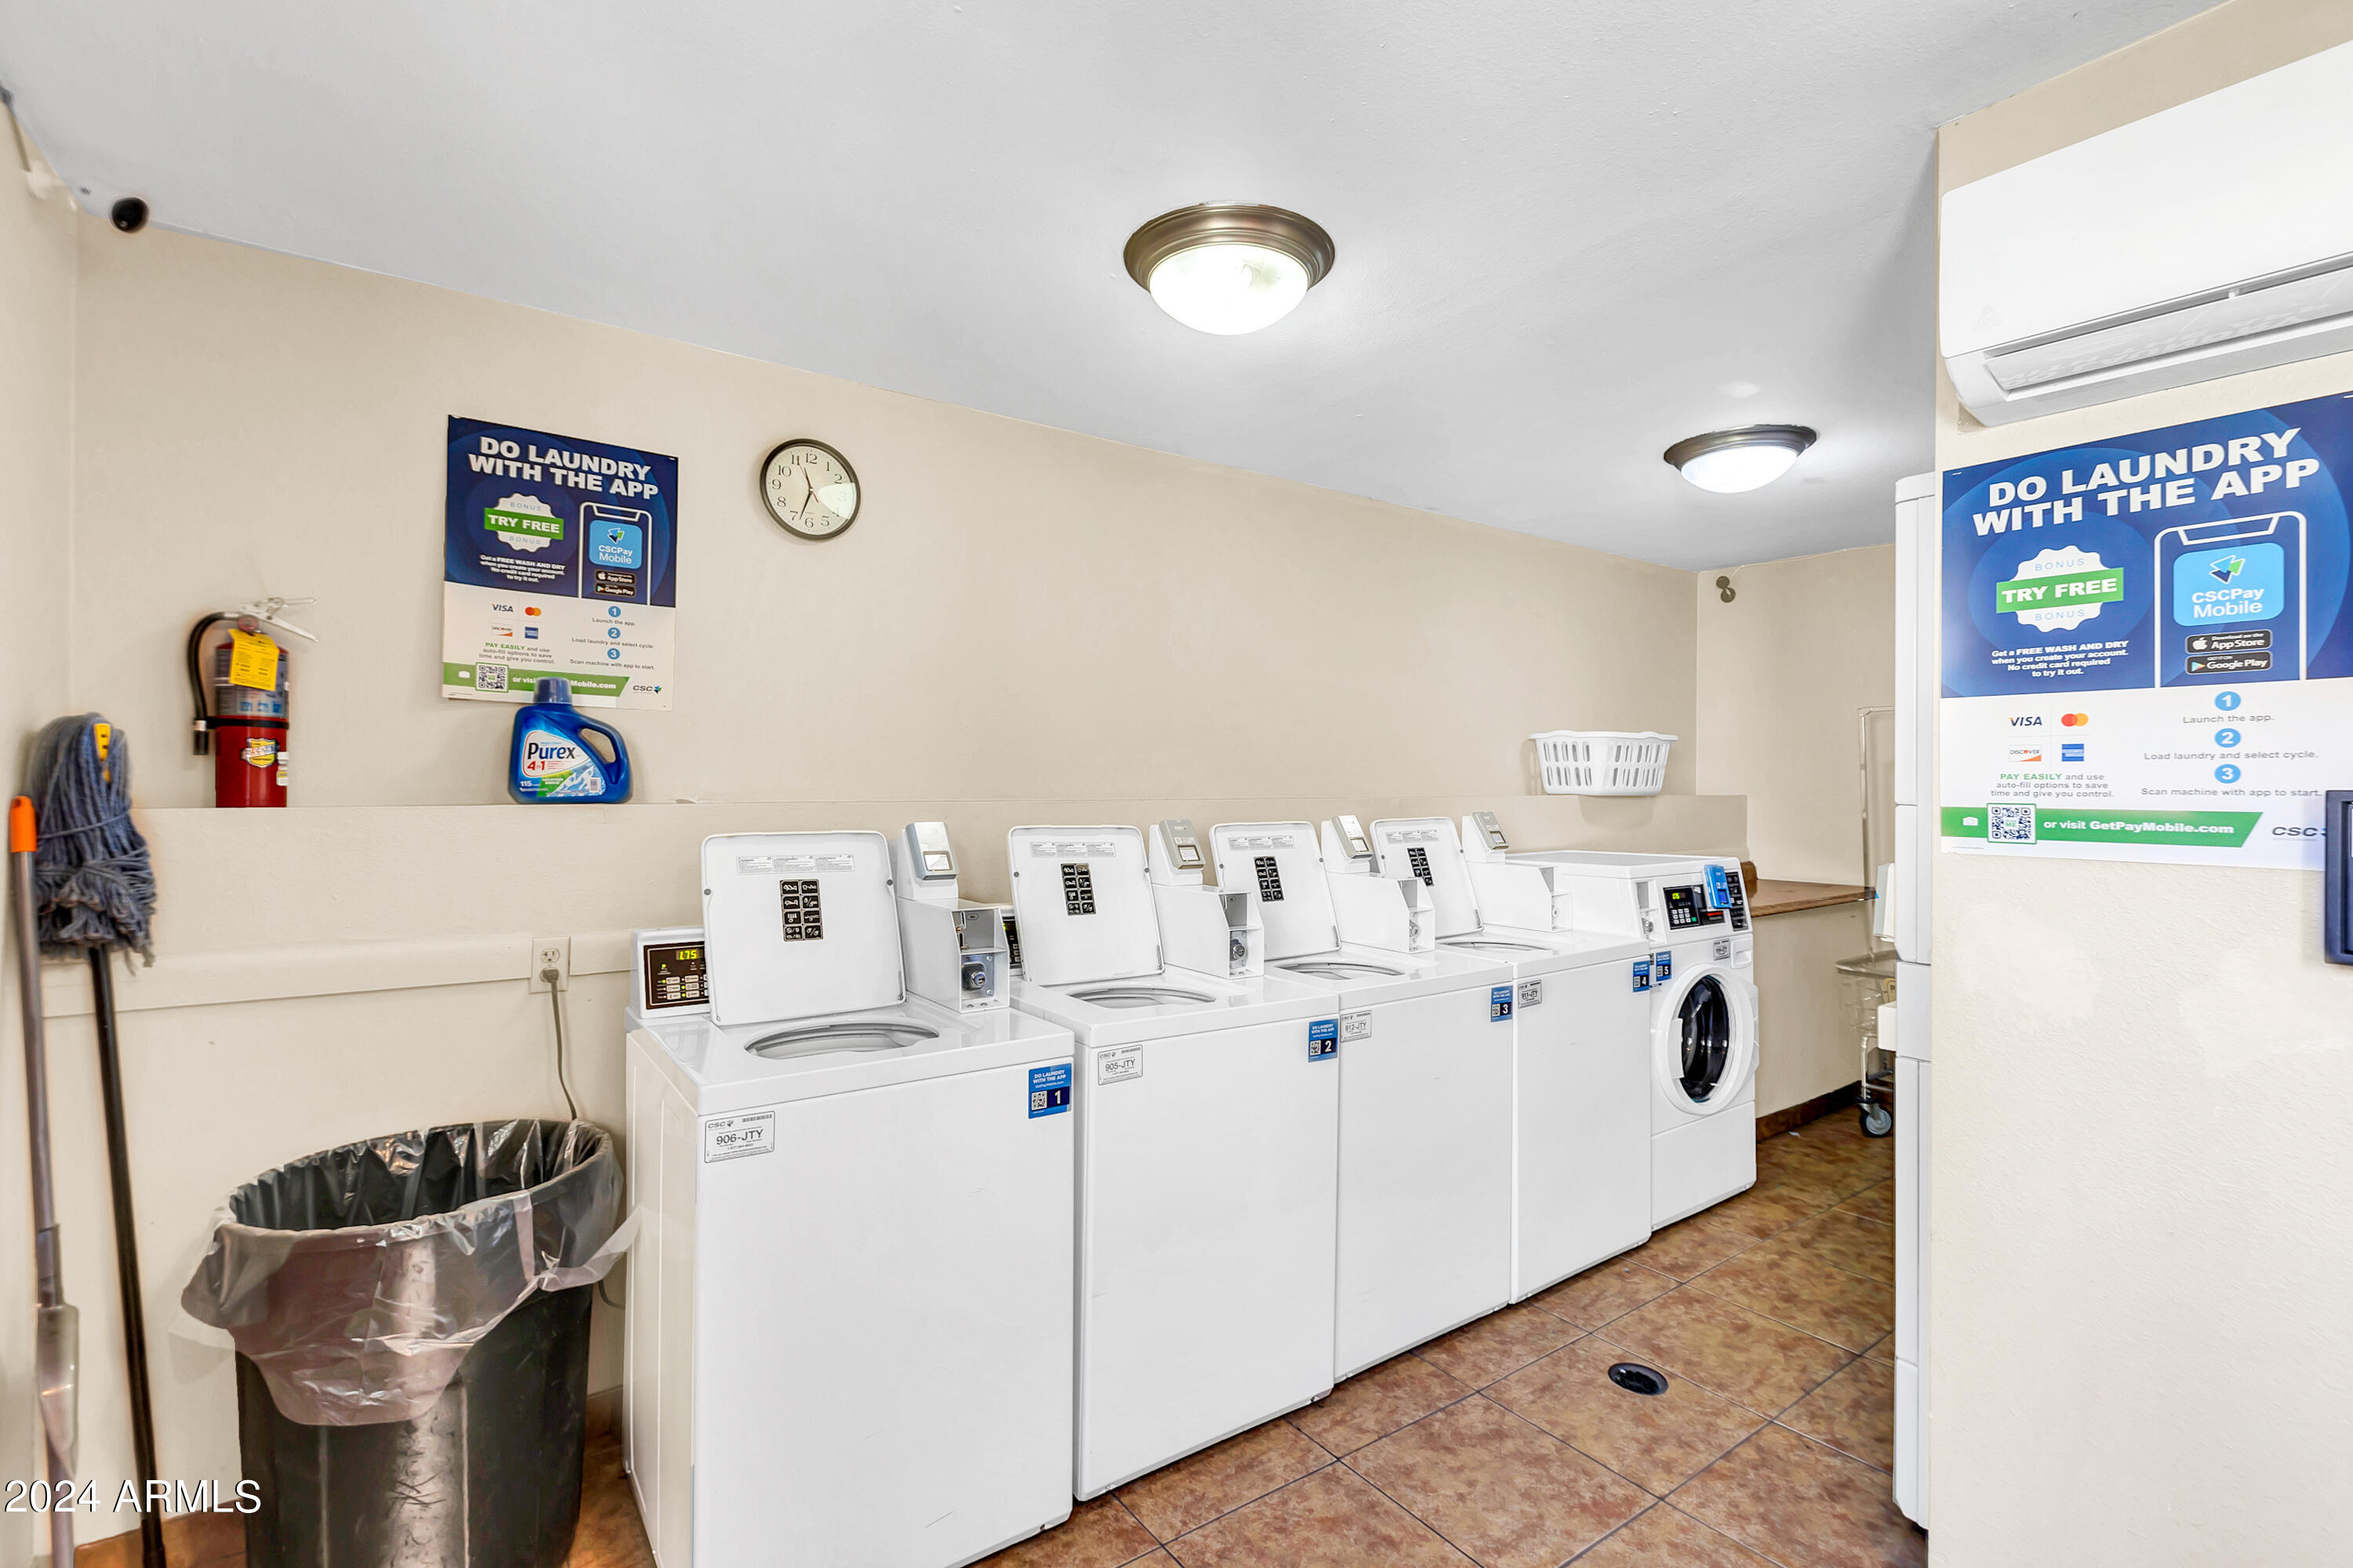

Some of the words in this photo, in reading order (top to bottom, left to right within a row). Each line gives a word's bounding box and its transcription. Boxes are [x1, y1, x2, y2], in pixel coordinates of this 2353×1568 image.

[479, 436, 521, 459] DO
[528, 445, 651, 482] LAUNDRY
[791, 454, 800, 465] 11
[806, 453, 817, 464] 12
[778, 464, 791, 477] 10
[826, 461, 830, 471] 1
[1989, 476, 2047, 508] DO
[2061, 427, 2302, 495] LAUNDRY
[468, 453, 542, 482] WITH
[550, 467, 603, 492] THE
[609, 480, 659, 500] APP
[834, 474, 842, 484] 2
[772, 478, 781, 490] 9
[776, 496, 787, 508] 8
[1972, 496, 2083, 537] WITH
[2097, 478, 2195, 517] THE
[2210, 457, 2321, 501] APP
[510, 501, 542, 511] BONUS
[790, 510, 798, 521] 7
[820, 515, 830, 526] 5
[487, 514, 518, 528] TRY
[522, 518, 560, 534] FREE
[805, 517, 814, 529] 6
[509, 536, 541, 545] BONUS
[598, 544, 633, 557] CSCPay
[598, 551, 632, 564] Mobile
[2034, 557, 2086, 572] BONUS
[2002, 584, 2047, 604] TRY
[2054, 577, 2118, 599] FREE
[2191, 588, 2265, 604] CSCPay
[492, 603, 514, 613] VISA
[2193, 600, 2264, 619] Mobile
[2034, 609, 2086, 622] BONUS
[2016, 646, 2043, 656] FREE
[2045, 645, 2078, 653] WASH
[2078, 642, 2104, 651] AND
[2105, 640, 2129, 649] DRY
[2211, 640, 2235, 649] App
[2235, 638, 2265, 648] Store
[2035, 653, 2063, 662] create
[2064, 653, 2086, 661] your
[2087, 649, 2129, 658] account.
[2021, 661, 2048, 670] credit
[2049, 660, 2070, 668] card
[2071, 658, 2111, 668] required
[2206, 660, 2244, 670] Google
[2244, 659, 2268, 668] Play
[570, 680, 616, 689] Mobile.com
[2222, 694, 2233, 707] 1
[2009, 716, 2042, 726] VISA
[2183, 715, 2224, 724] Launch
[2228, 714, 2246, 722] the
[2249, 714, 2275, 723] app.
[2221, 731, 2235, 744] 2
[527, 742, 576, 759] Purex
[2173, 752, 2216, 761] laundry
[2283, 750, 2319, 759] cycle.
[527, 761, 536, 770] 4
[2220, 767, 2234, 780] 3
[2033, 790, 2053, 799] give
[2059, 820, 2086, 830] visit
[2089, 820, 2235, 834] GetPayMobile.com
[2271, 826, 2318, 837] CSC
[1664, 966, 1669, 975] 5
[1641, 977, 1646, 985] 4
[1503, 1004, 1508, 1014] 3
[1325, 1040, 1332, 1052] 2
[1105, 1059, 1136, 1071] 905-JTY
[1054, 1090, 1061, 1104] 1
[716, 1129, 764, 1145] 906-JTY
